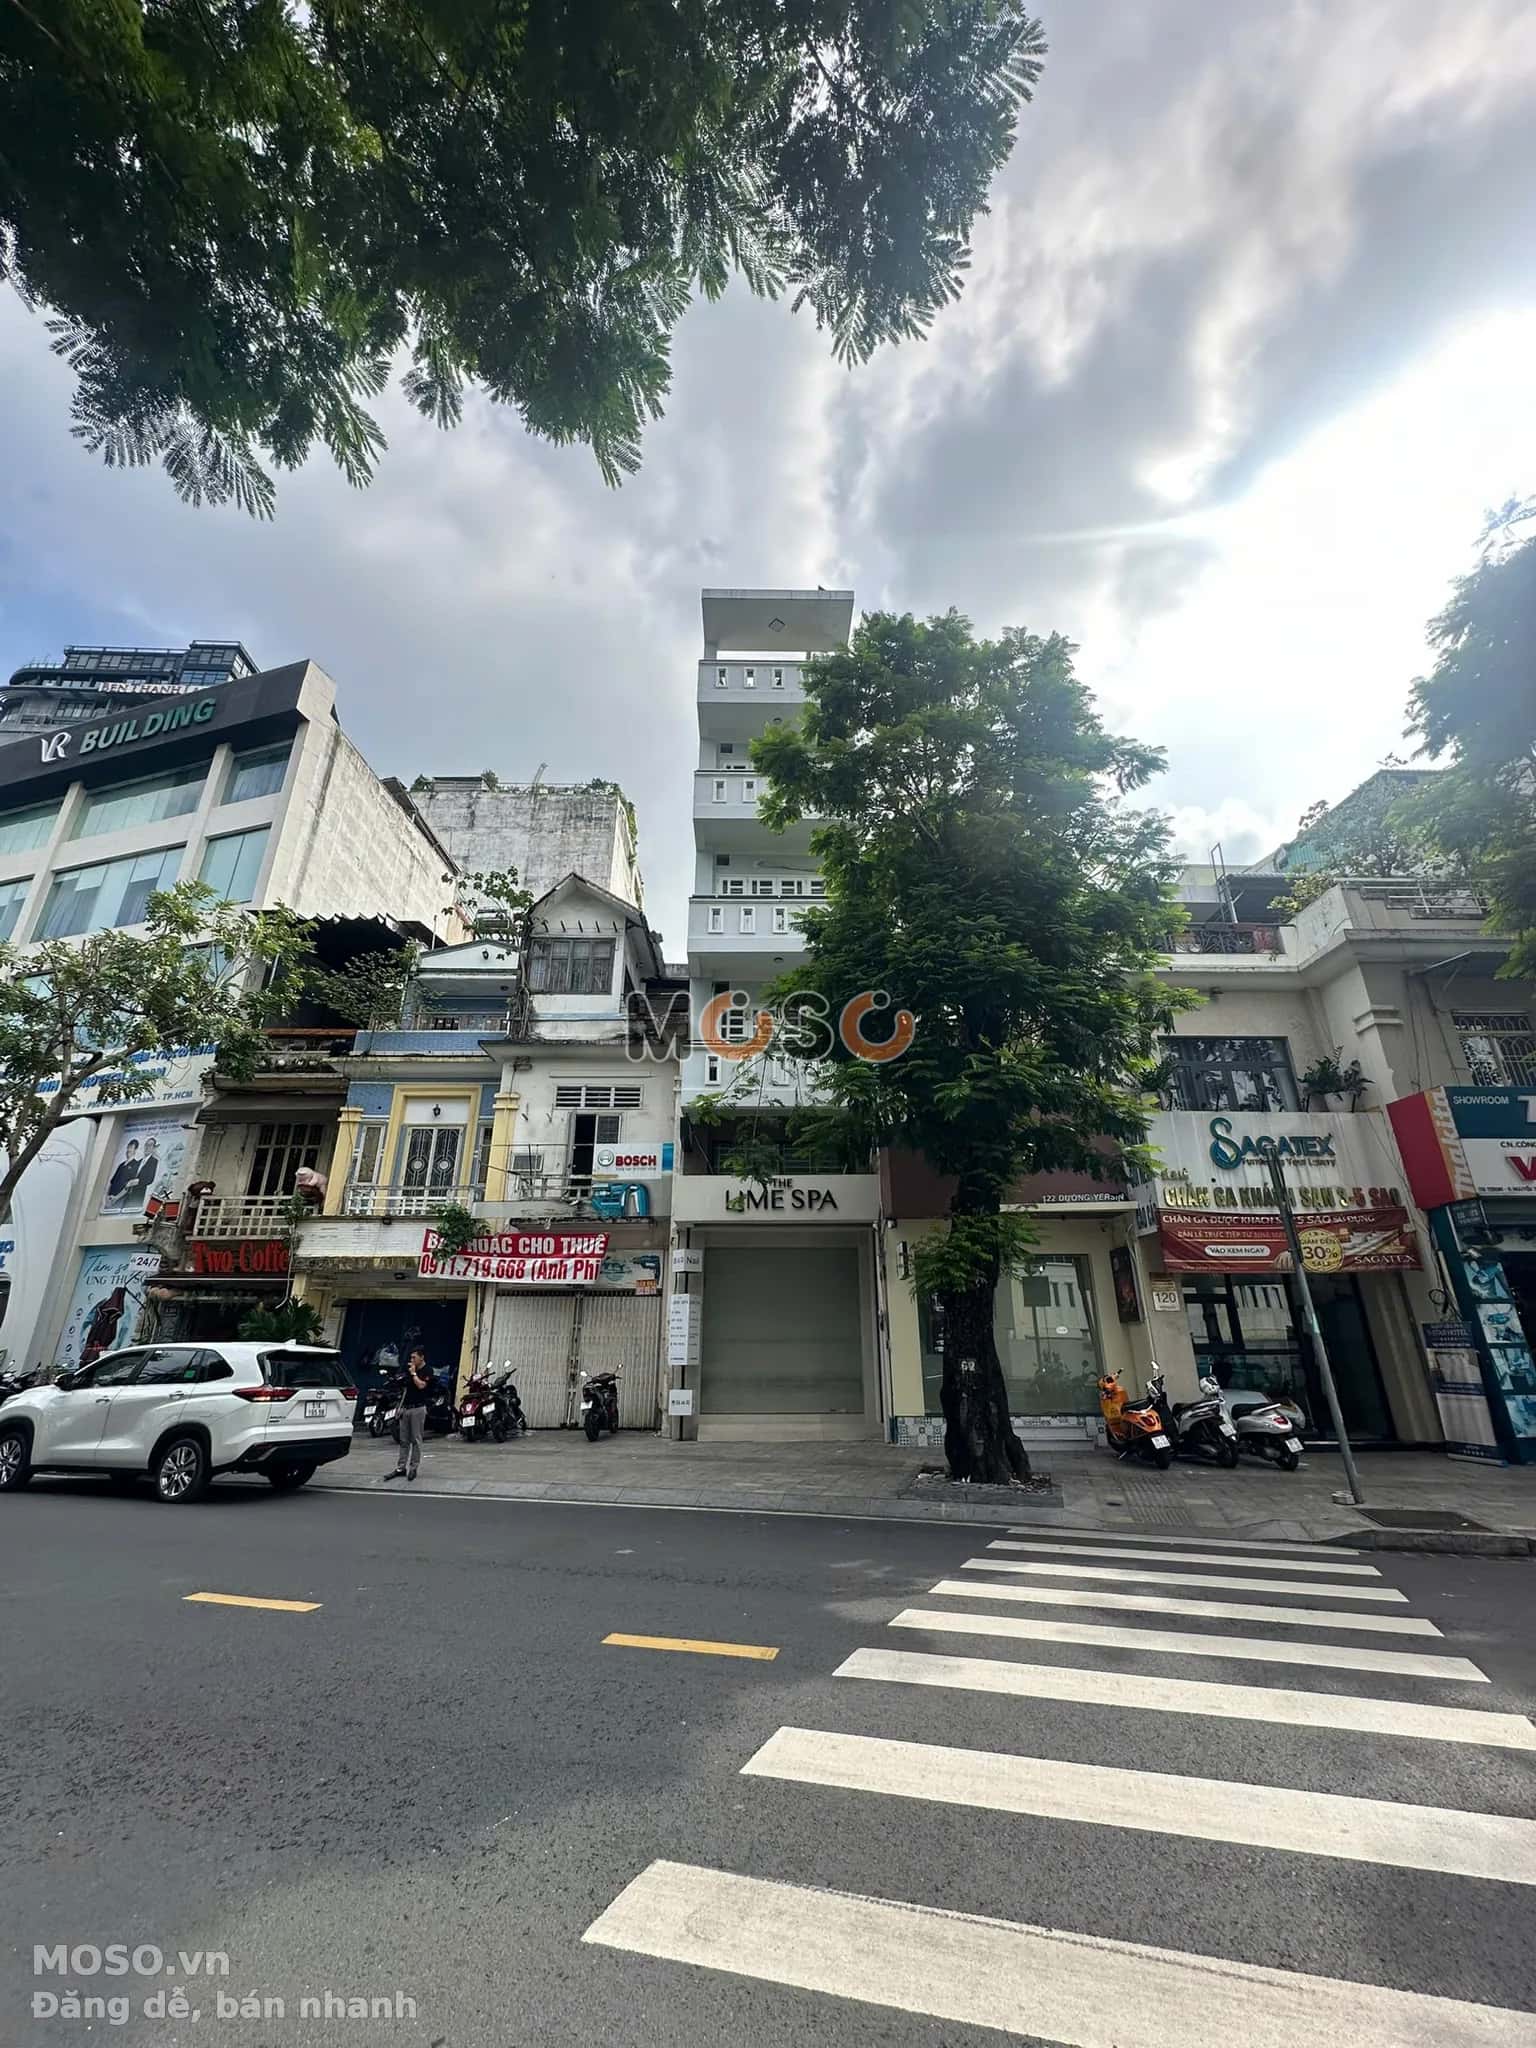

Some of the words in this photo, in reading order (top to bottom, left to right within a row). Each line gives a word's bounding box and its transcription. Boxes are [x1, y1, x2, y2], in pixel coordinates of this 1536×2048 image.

[79, 698, 217, 754] BUILDING
[162, 1090, 194, 1101] TP.HCM
[1453, 1096, 1509, 1104] SHOWROOM
[1210, 1117, 1336, 1169] SAGATEX
[615, 1155, 657, 1167] BOSCH
[772, 1178, 793, 1188] THE
[791, 1189, 838, 1210] SPA
[1213, 1186, 1238, 1207] GA
[1368, 1186, 1401, 1206] SAO
[1306, 1215, 1332, 1225] SAO
[518, 1237, 555, 1255] CHO
[560, 1234, 605, 1255] THUÊ
[191, 1240, 234, 1274] Two
[1304, 1246, 1338, 1259] 30%
[136, 1256, 159, 1268] 24/7
[1354, 1255, 1416, 1264] SAGATEX
[531, 1259, 567, 1282] (Anh
[1155, 1292, 1177, 1304] 120
